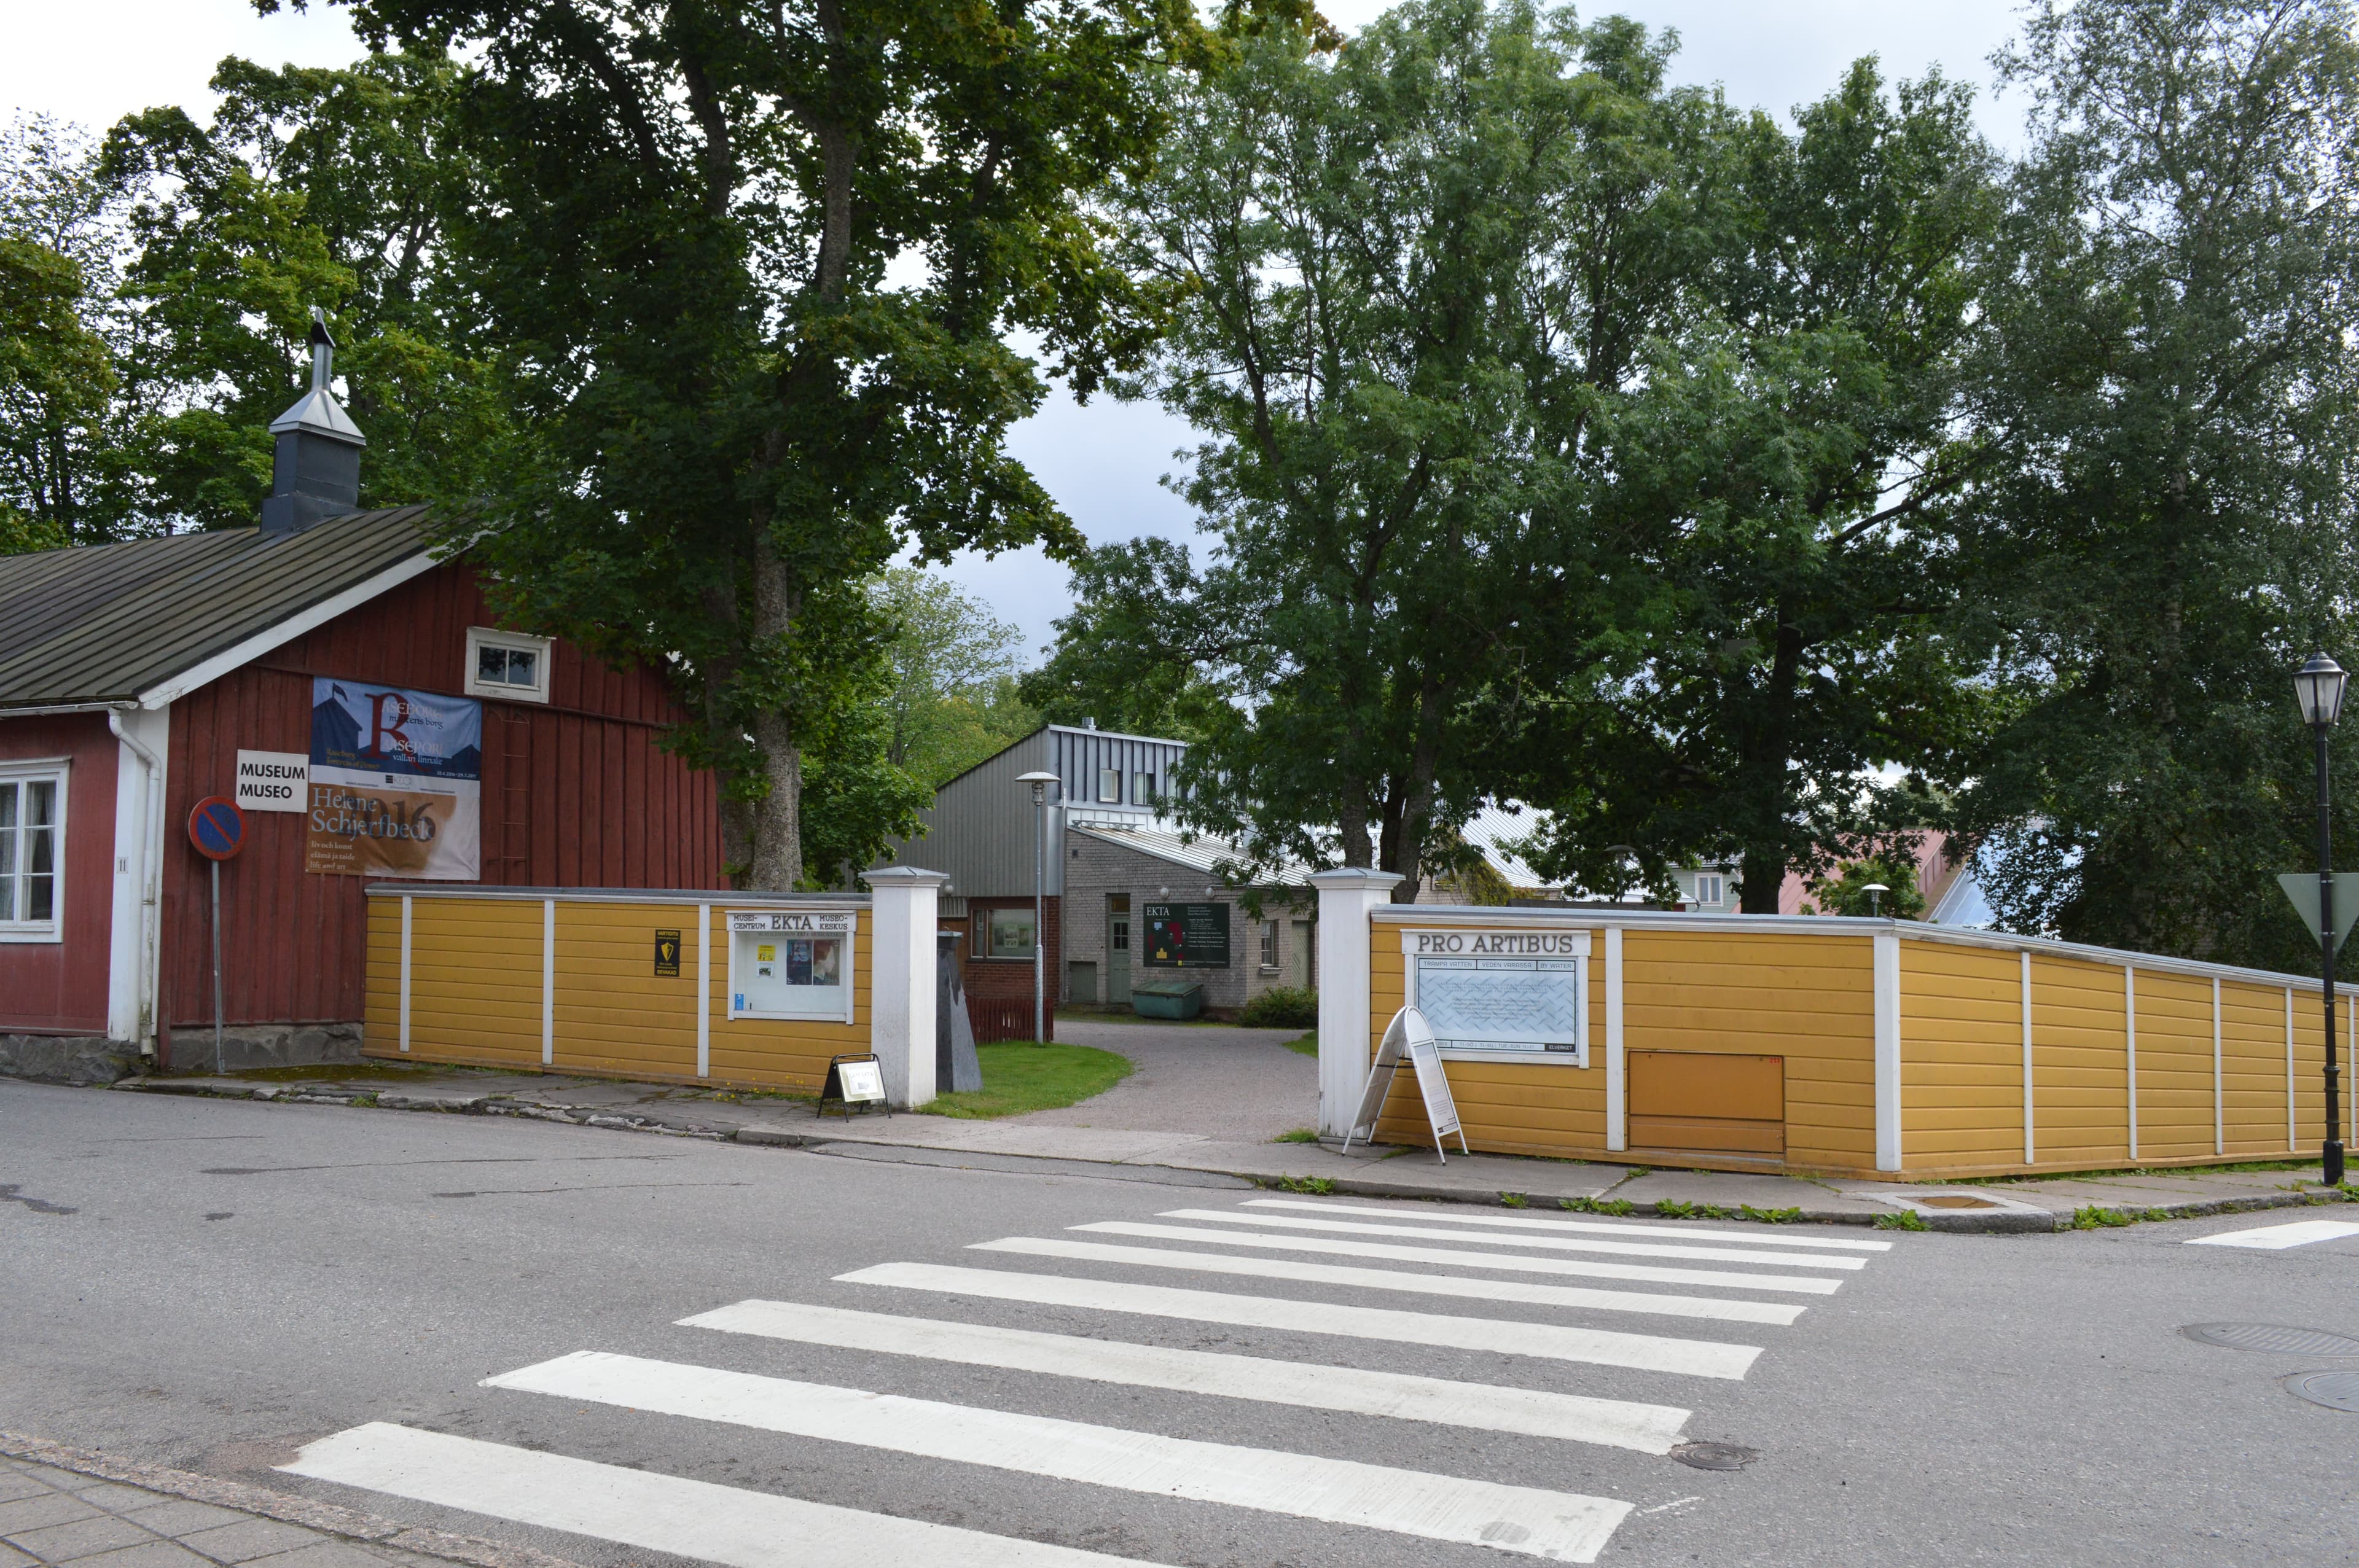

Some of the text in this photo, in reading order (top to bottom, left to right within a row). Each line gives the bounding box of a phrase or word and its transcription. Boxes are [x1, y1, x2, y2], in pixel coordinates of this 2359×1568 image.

[426, 717, 443, 730] borg
[393, 754, 443, 765] vallan linnake
[240, 763, 305, 780] MUSEUM
[240, 784, 292, 799] MUSEO
[313, 787, 378, 812] Helene
[311, 809, 433, 841] Schjerfbeck
[311, 851, 331, 859] elämä
[332, 852, 338, 862] ja
[1146, 907, 1170, 916] EKTA
[771, 915, 813, 930] EKTA
[1418, 935, 1573, 953] PRO ARTIBUS
